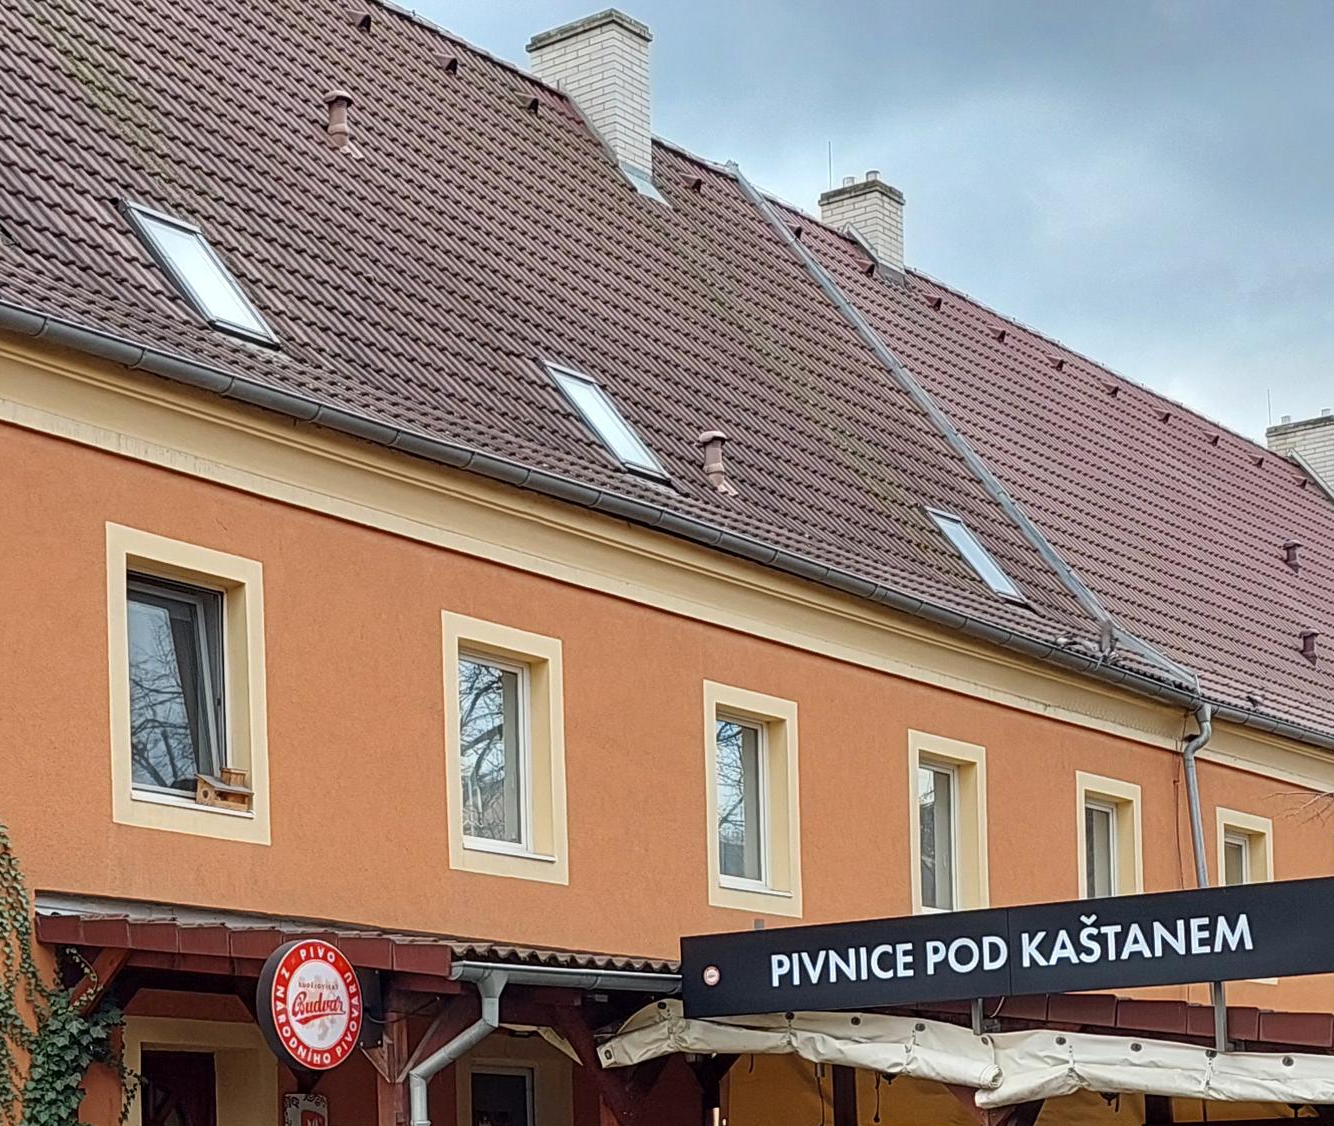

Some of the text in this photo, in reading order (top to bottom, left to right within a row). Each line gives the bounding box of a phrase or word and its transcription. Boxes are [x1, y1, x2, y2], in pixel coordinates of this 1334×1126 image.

[299, 946, 335, 962] PIVO
[771, 942, 914, 987] PIVNICE
[926, 936, 1008, 975] POD
[1021, 913, 1254, 968] KAŠTANEM
[275, 967, 360, 1064] Z NÁRODNÍHO PIVOVARU
[292, 991, 346, 1022] Budvar
